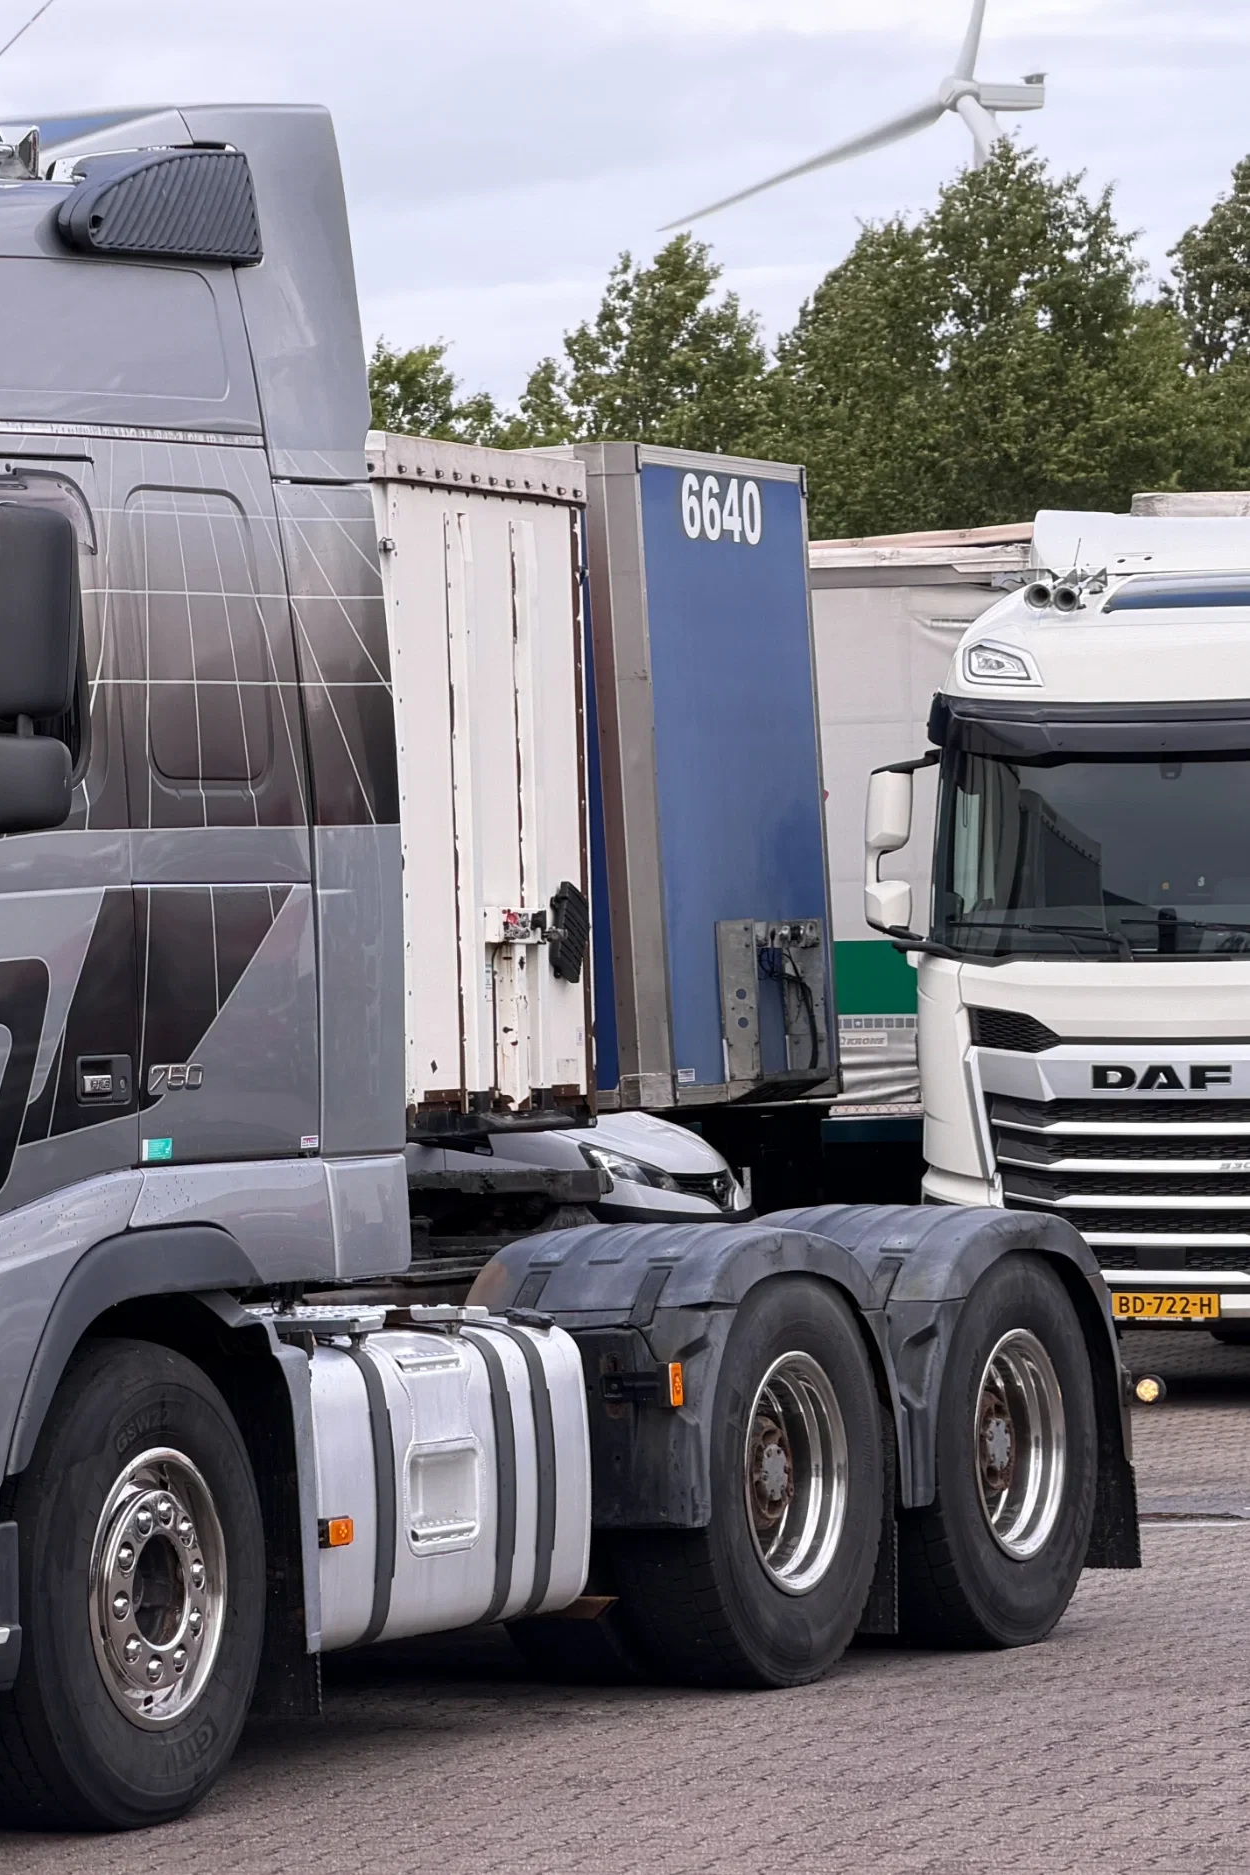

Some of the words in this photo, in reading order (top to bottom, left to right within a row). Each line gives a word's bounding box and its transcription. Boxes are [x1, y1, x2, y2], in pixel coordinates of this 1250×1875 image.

[681, 472, 762, 545] 6640
[148, 1063, 204, 1092] 750
[1091, 1064, 1232, 1091] DAF
[1118, 1296, 1212, 1314] BD-722-H
